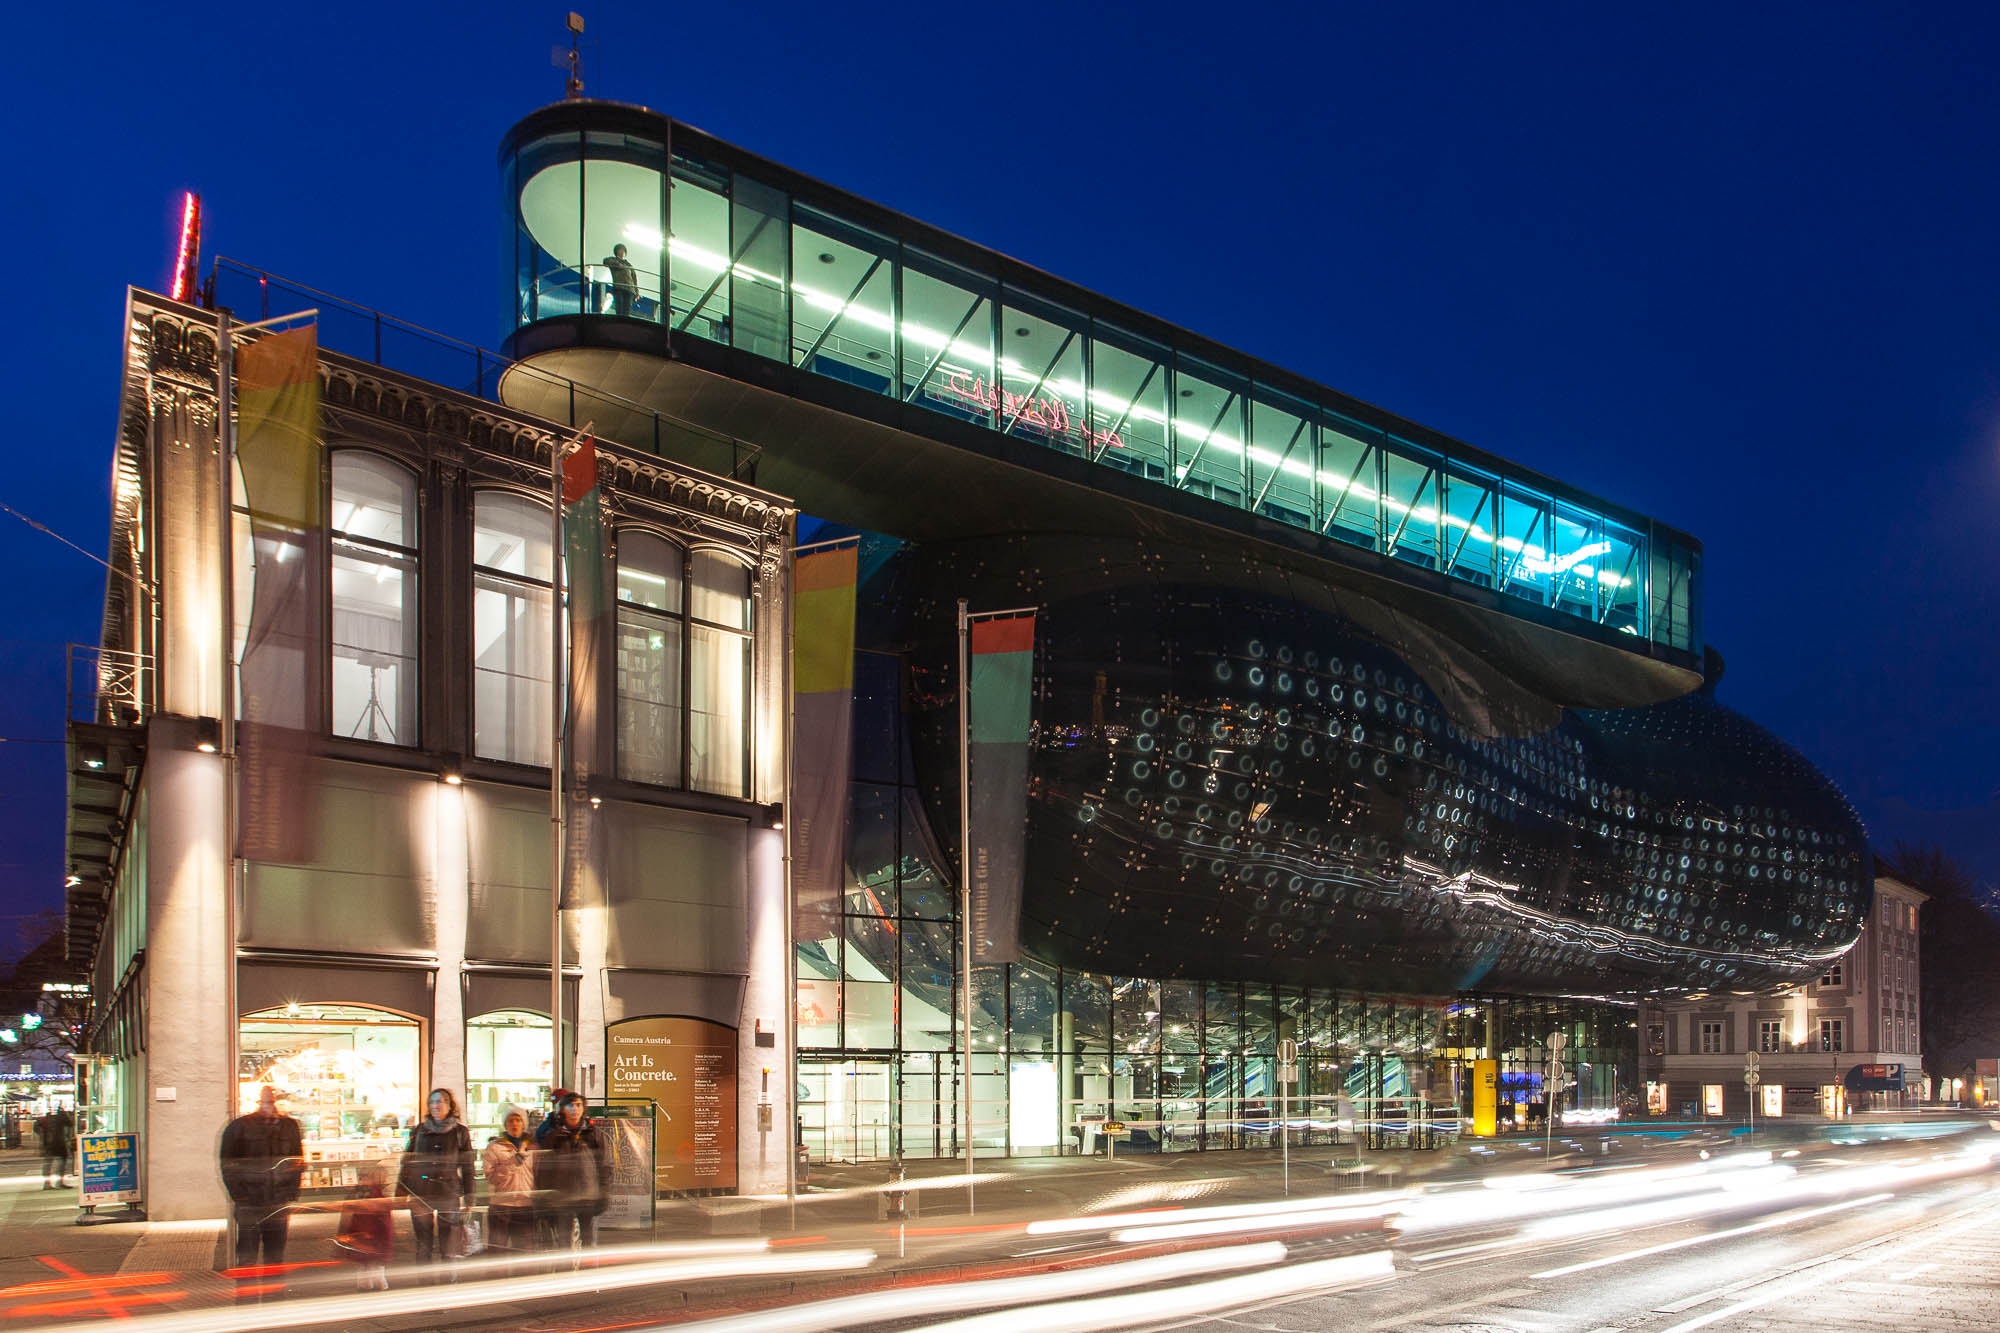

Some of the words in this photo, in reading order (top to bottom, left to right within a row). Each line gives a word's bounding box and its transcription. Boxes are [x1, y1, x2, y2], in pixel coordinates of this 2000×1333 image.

[975, 847, 988, 879] Graz
[614, 1035, 644, 1044] Camera
[645, 1036, 672, 1045] Austria
[614, 1054, 638, 1067] Art
[641, 1054, 654, 1067] Is
[613, 1067, 677, 1081] Concrete.
[83, 1137, 129, 1153] Latin
[87, 1150, 117, 1162] night
